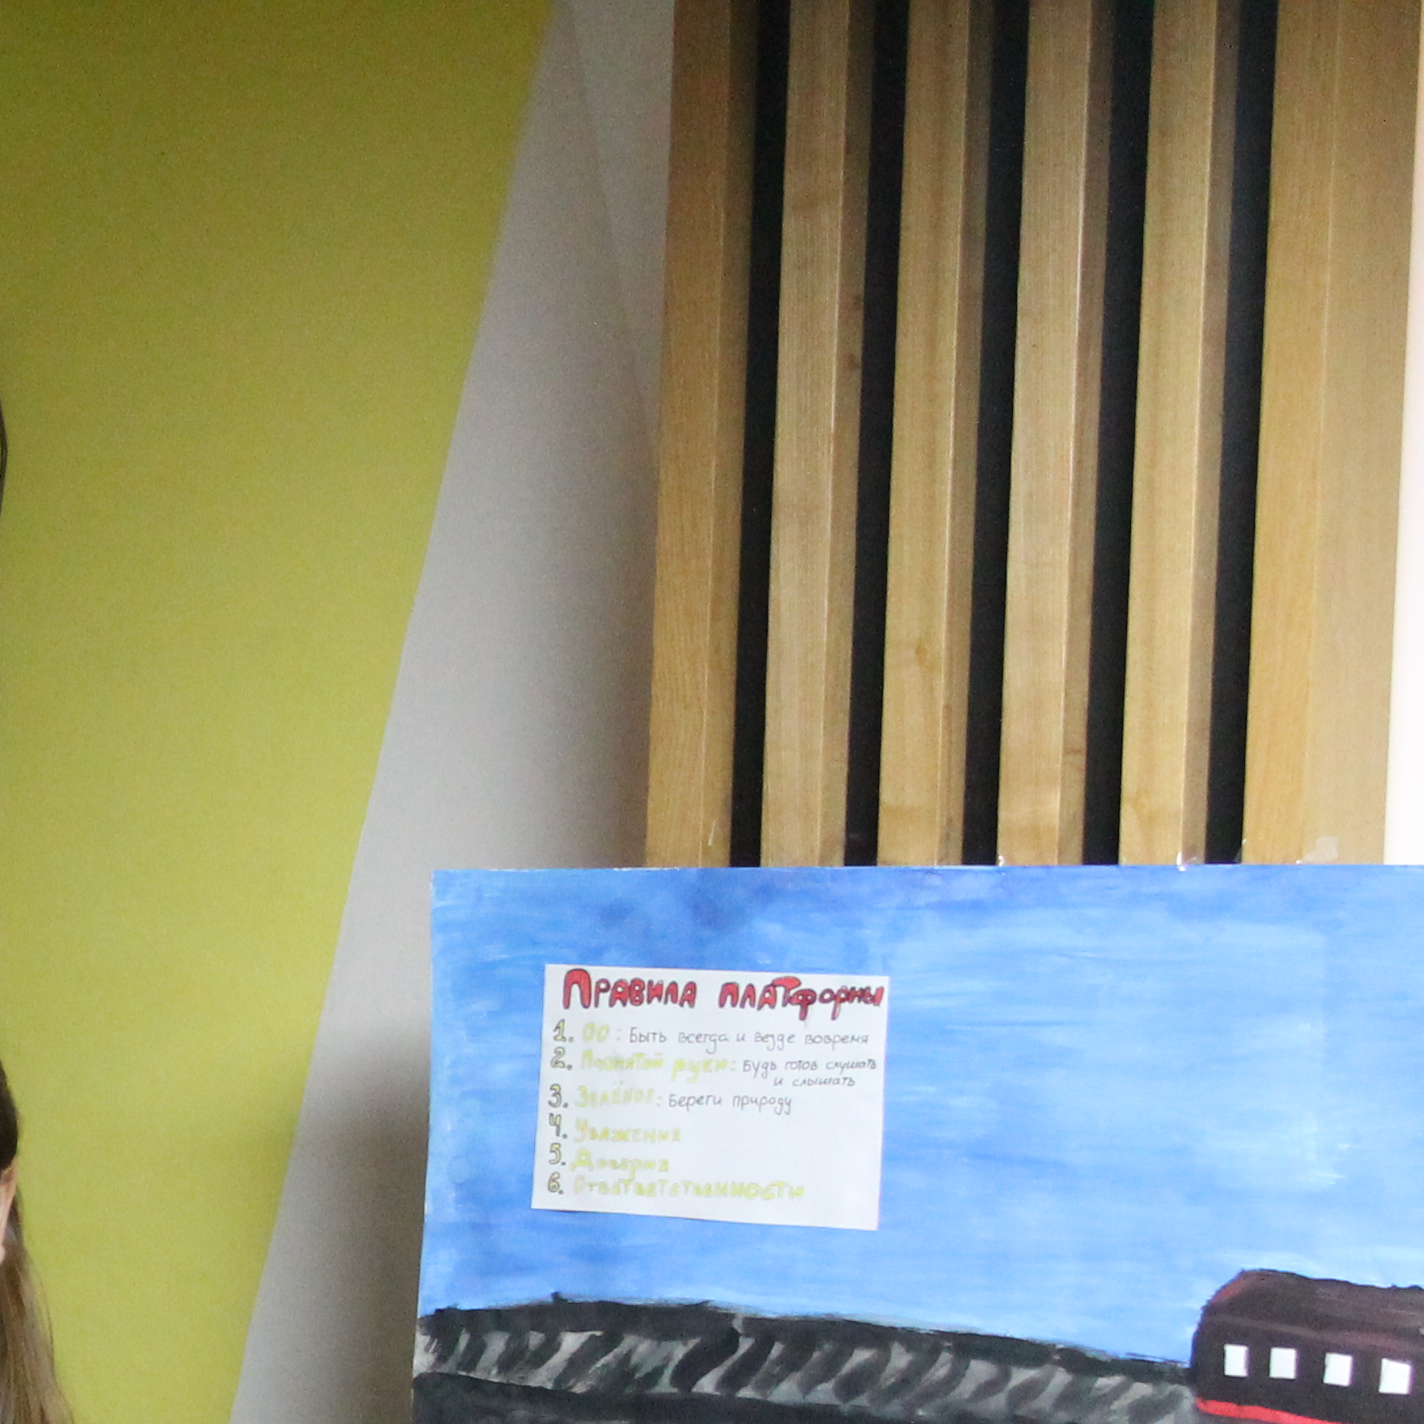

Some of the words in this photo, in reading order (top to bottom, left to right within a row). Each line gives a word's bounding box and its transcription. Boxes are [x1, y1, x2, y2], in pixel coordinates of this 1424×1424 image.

[562, 968, 698, 1010] Правила
[629, 1026, 668, 1044] Быть
[677, 1031, 730, 1055] всегда
[736, 1033, 746, 1043] и
[753, 1031, 797, 1051] везде
[804, 1033, 870, 1052] вовремя
[742, 1059, 778, 1079] Будь
[784, 1060, 819, 1072] готов
[773, 1075, 784, 1087] и
[668, 1093, 723, 1113] Береги
[732, 1095, 793, 1116] природу
